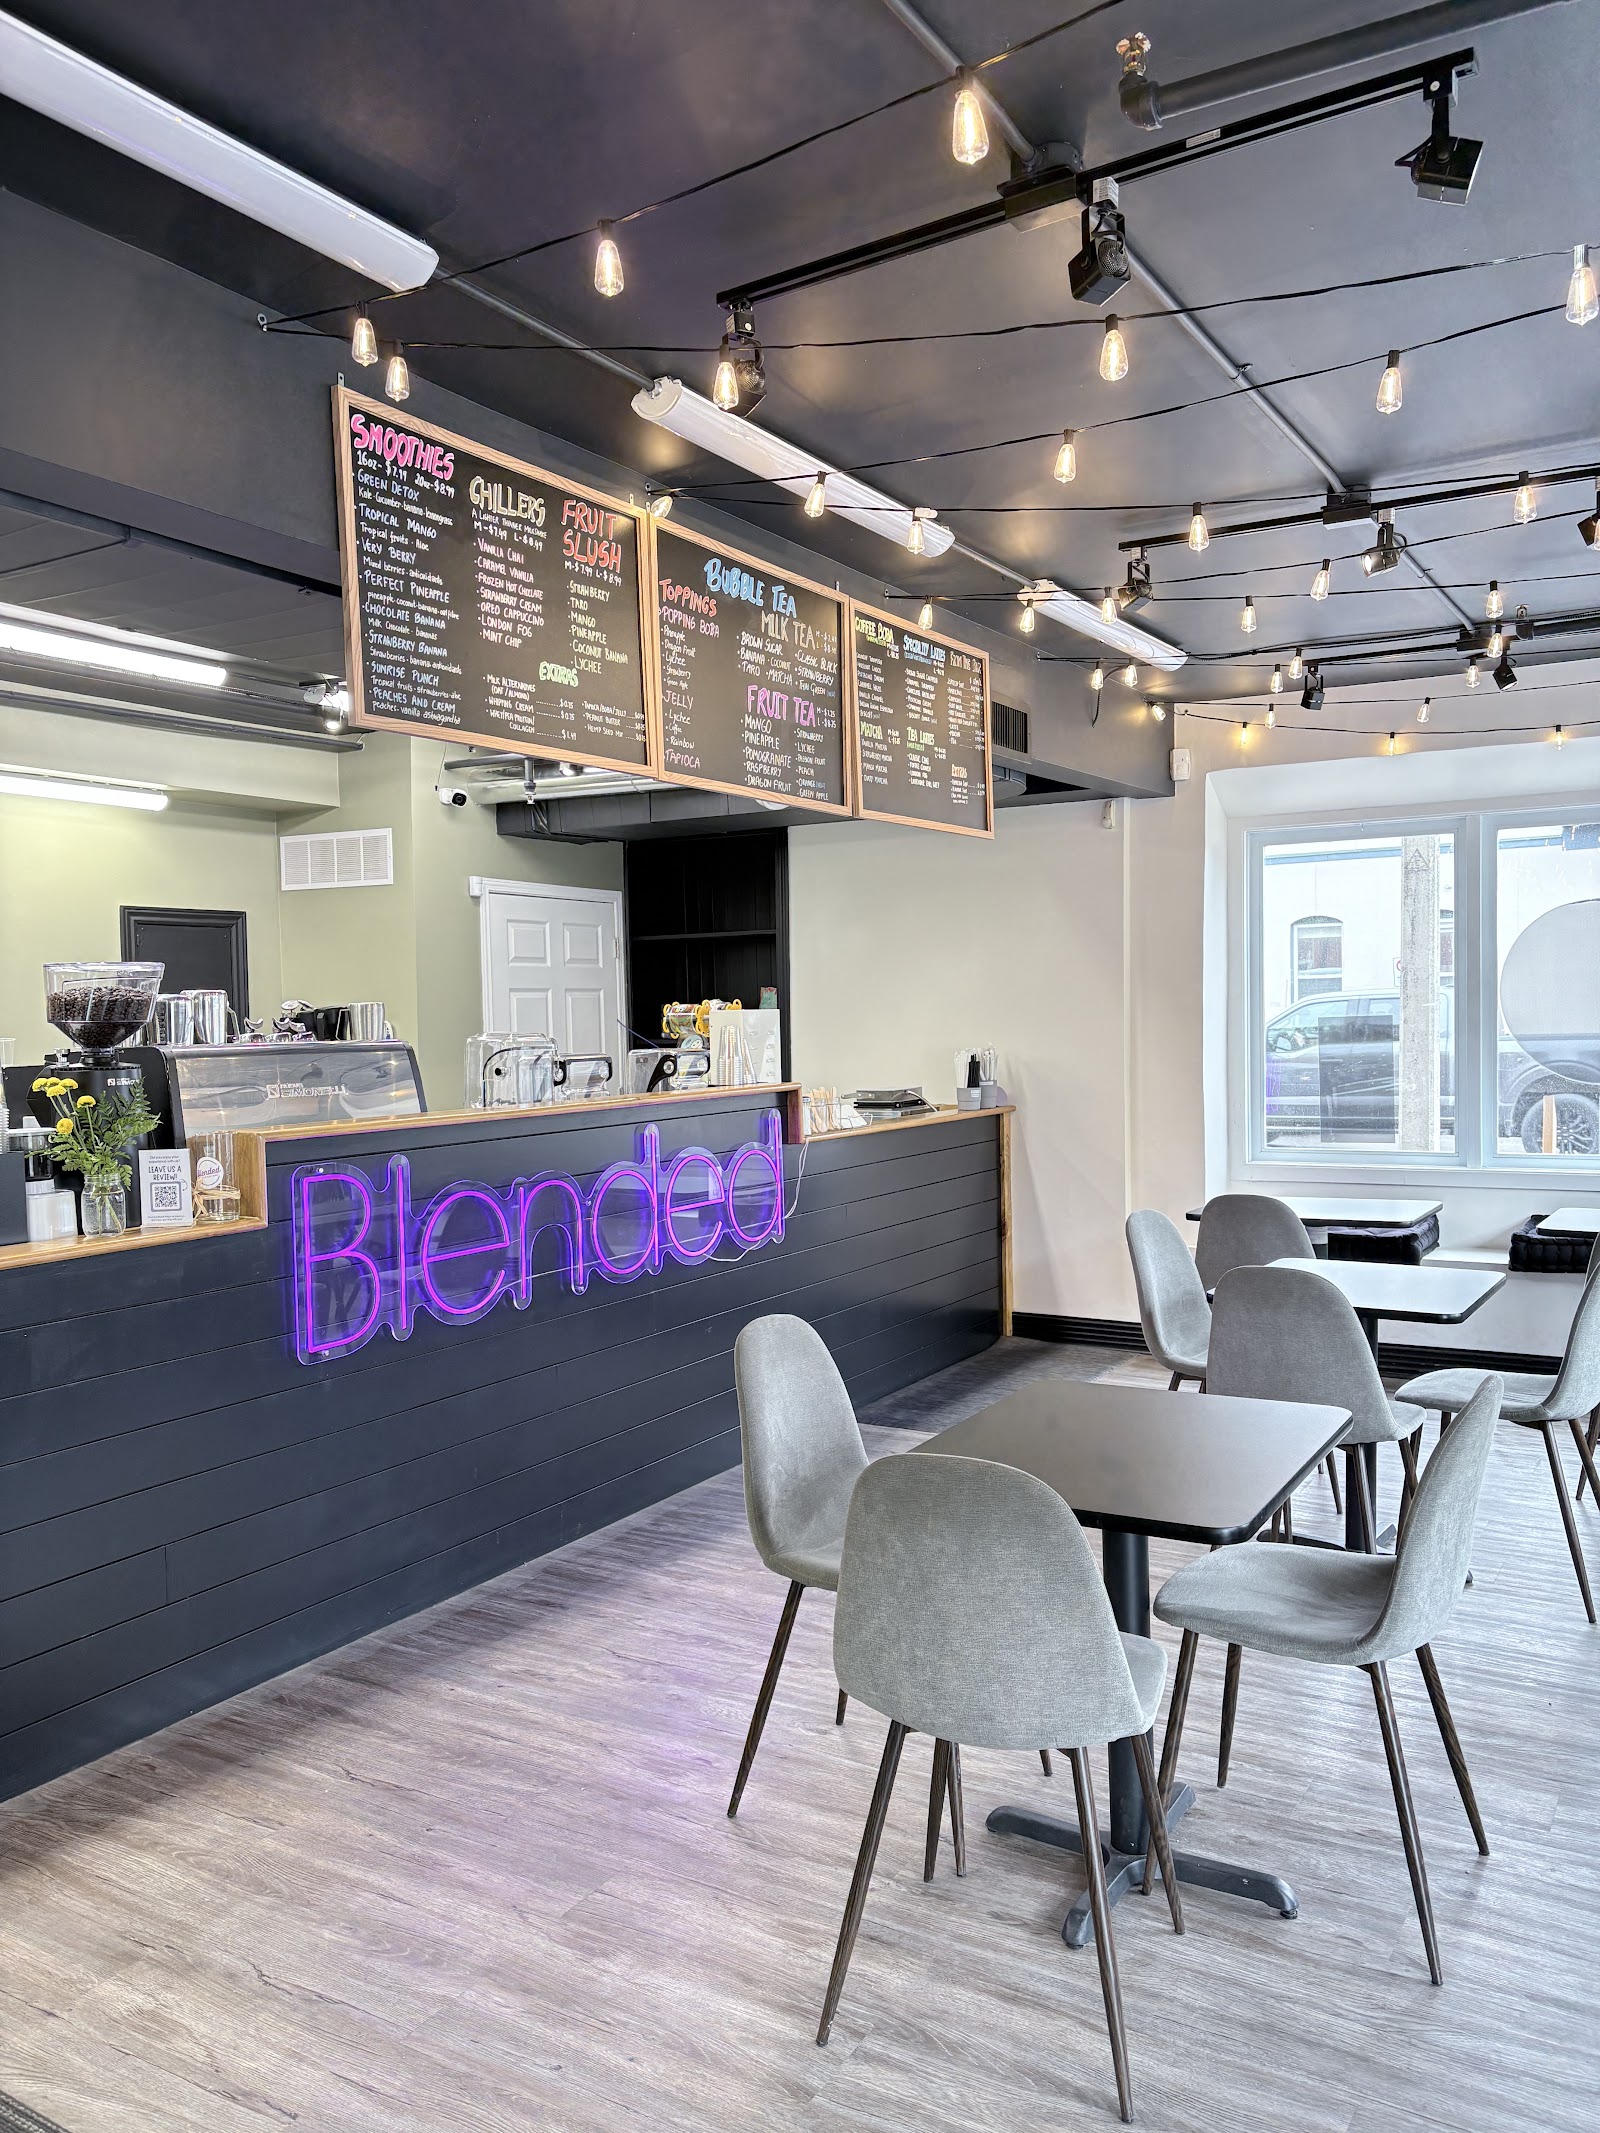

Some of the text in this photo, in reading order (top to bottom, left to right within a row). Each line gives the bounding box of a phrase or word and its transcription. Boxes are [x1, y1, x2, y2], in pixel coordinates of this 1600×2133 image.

[351, 414, 454, 480] SMOOTHIES
[357, 469, 420, 501] GREEN DETOX
[470, 476, 546, 527] CHILLERS
[472, 508, 478, 518] A
[359, 503, 437, 539] TROPICAL MANGO
[561, 500, 617, 540] FRUIT
[360, 522, 387, 540] Tropical
[390, 531, 408, 544] fruits
[362, 537, 416, 565] VERY BERRY
[478, 538, 524, 564] VANILLA CHAI
[563, 529, 622, 574] SLUSH
[364, 556, 381, 570] Mixed
[384, 561, 405, 575] berries
[478, 556, 534, 584] CARAMEL VANILLA
[364, 570, 450, 603] PERFECT PINEAPPLE
[478, 572, 504, 588] FROZEN
[506, 580, 518, 594] HOT
[704, 558, 796, 618] BUBBLE TEA
[368, 592, 394, 605] pineapple
[480, 586, 542, 614] STRAWBERRY CREAM
[570, 597, 588, 610] TARO
[659, 578, 716, 617] TOPPINGS
[365, 602, 446, 629] CHOCOLATE BANANA
[480, 602, 544, 626] OREO CAPPUCCINO
[571, 611, 596, 628] MANGO
[662, 606, 720, 638] POPPING BOBA
[416, 627, 438, 640] bananas
[482, 614, 532, 638] LONDON FOG
[571, 625, 606, 644] PINEAPPLE
[762, 610, 788, 642] MILK
[793, 620, 816, 650] TEA
[878, 622, 894, 645] BOBA
[368, 630, 448, 657] STRAWBERRY BANANA
[482, 628, 522, 648] MINT CHIP
[572, 640, 602, 658] COCONUT
[742, 631, 784, 656] BROWN SUGAR
[575, 656, 602, 674] LYCHEE
[666, 651, 686, 666] Lychee
[740, 647, 791, 670] BANANA COCONUT
[820, 658, 838, 674] BLACK
[371, 661, 439, 687] SUNRISE PUNCH
[539, 661, 578, 688] EXTRAS
[742, 660, 792, 686] TARO MATCHA
[798, 666, 834, 686] STRAWBERRY
[397, 680, 412, 692] fruits
[372, 700, 396, 712] peaches
[373, 687, 456, 713] PEACHES AND CREAM
[515, 701, 534, 713] CREAM
[664, 690, 694, 710] JELLY
[748, 685, 816, 728] FRUIT TEA
[669, 709, 690, 724] Lychee
[745, 714, 772, 734] MANGO
[744, 730, 780, 750] PINEAPPLE
[860, 720, 882, 740] MATCHA
[670, 736, 694, 749] Rainbow
[665, 749, 700, 769] TAPIOCA
[746, 761, 782, 777] RASPBERRY
[748, 774, 792, 792] DRAGON FRUIT
[301, 1116, 783, 1354] Blended
